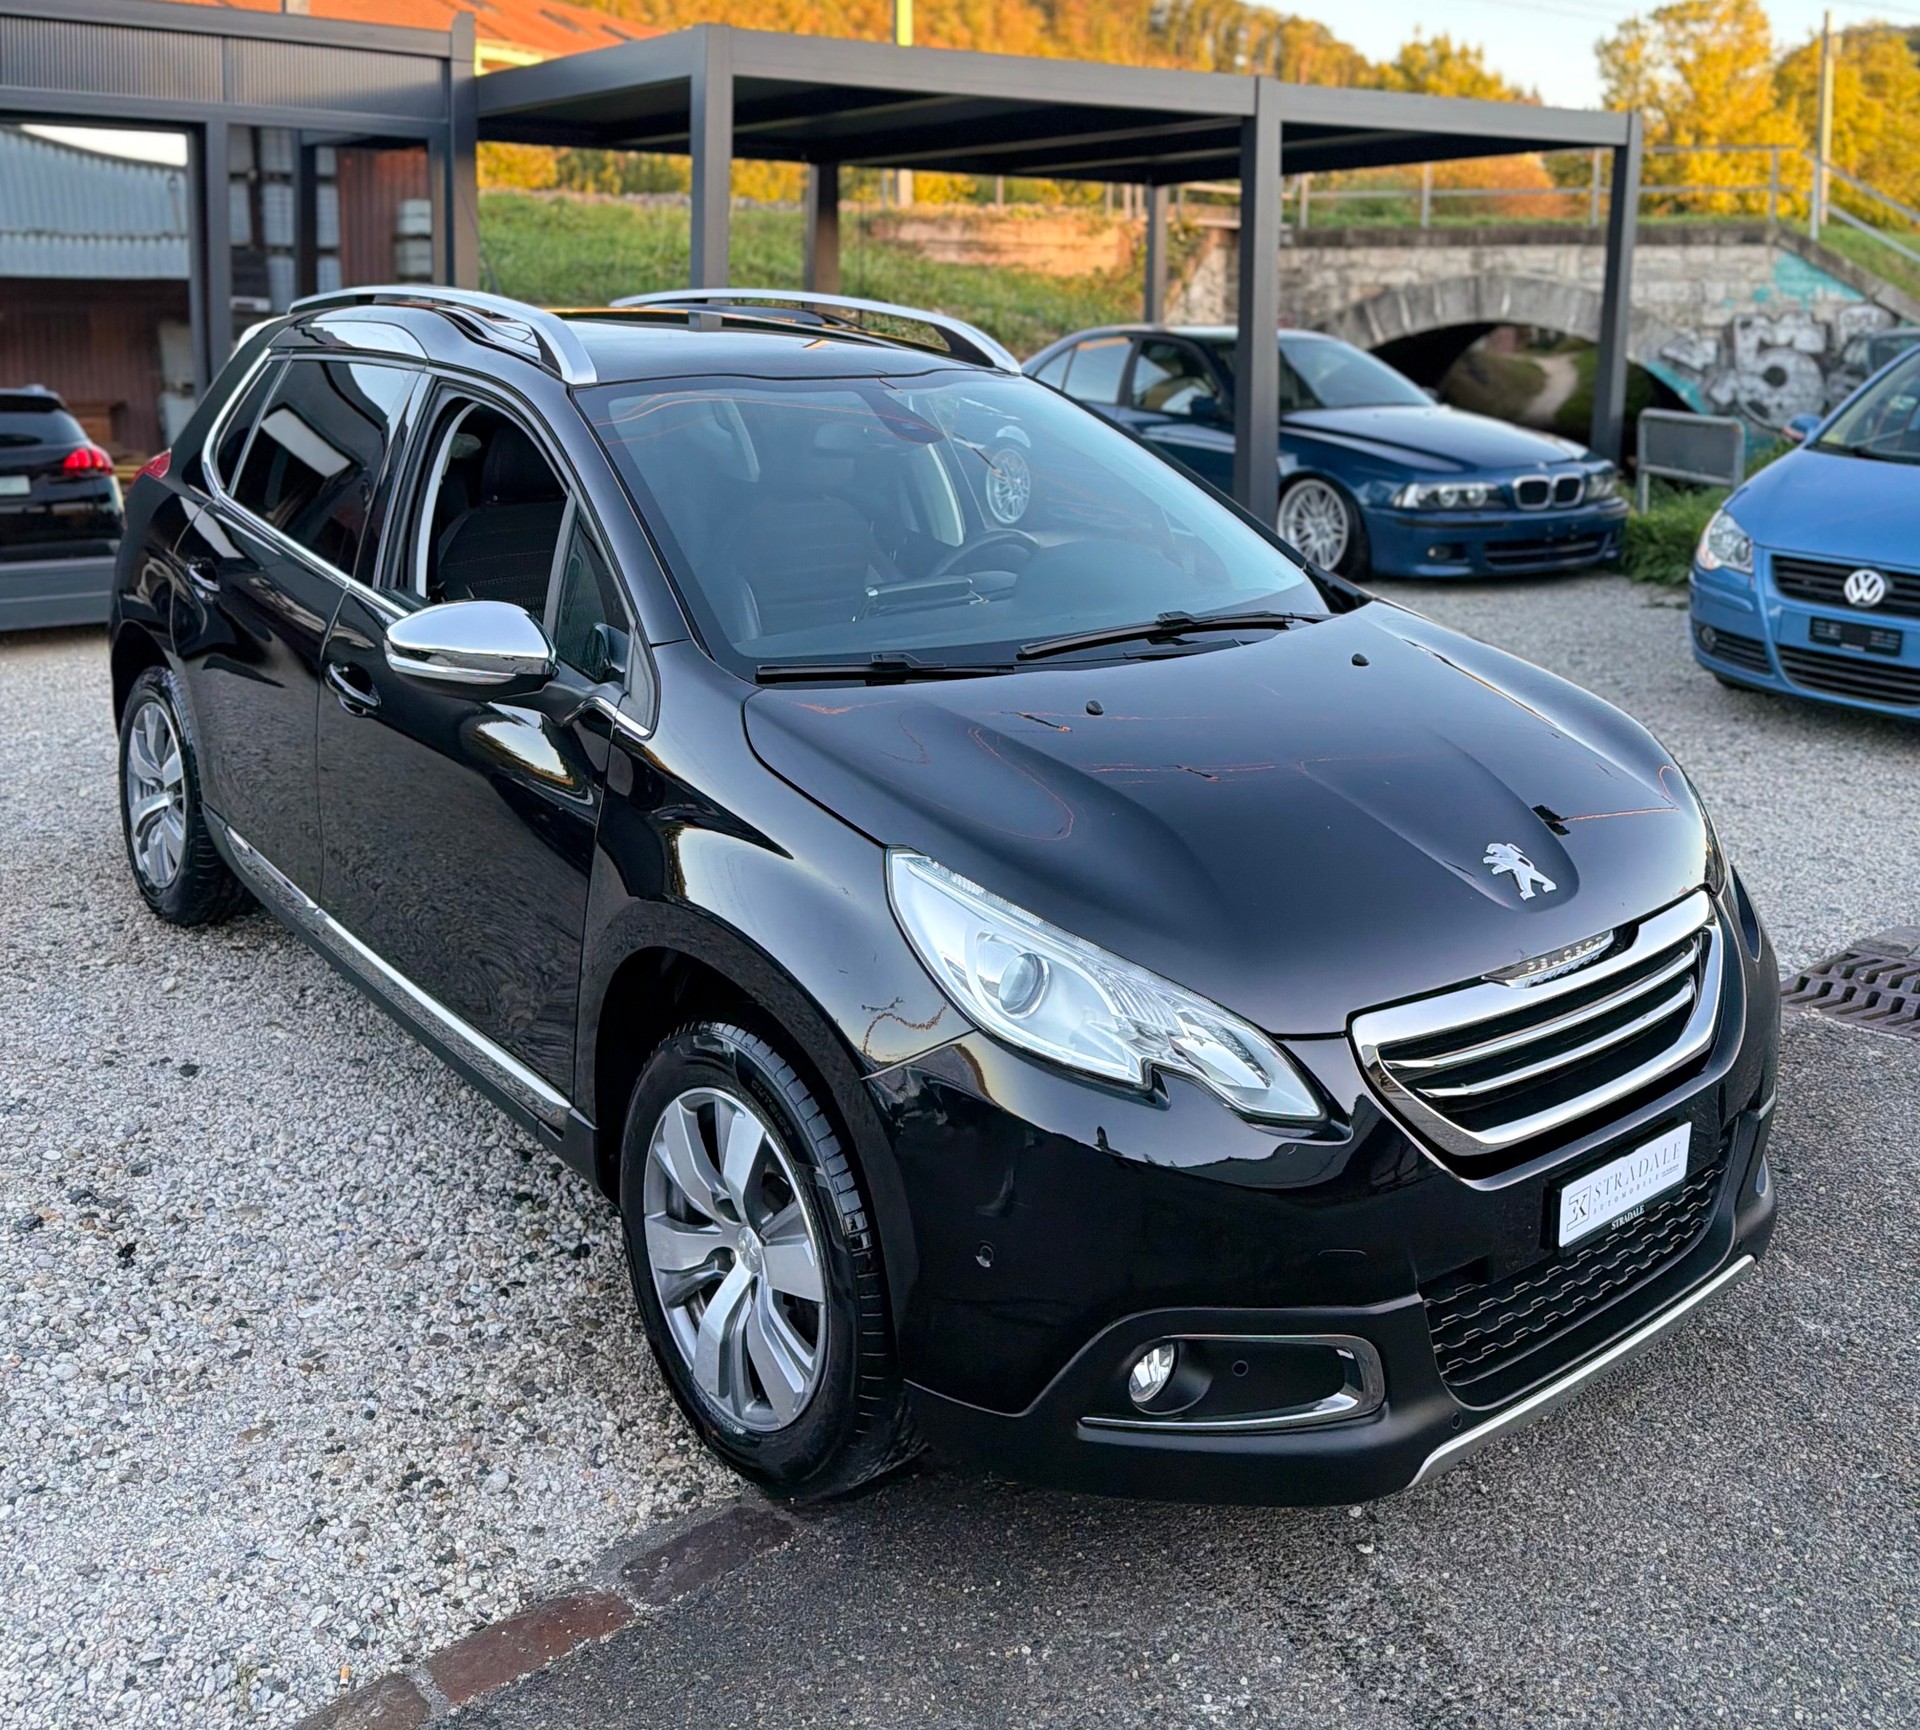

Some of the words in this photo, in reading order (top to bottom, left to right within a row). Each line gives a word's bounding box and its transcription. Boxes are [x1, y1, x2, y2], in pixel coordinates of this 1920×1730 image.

[1844, 569, 1885, 608] VW
[1594, 1141, 1681, 1202] STRADALE
[1611, 1204, 1646, 1231] STRADALE
